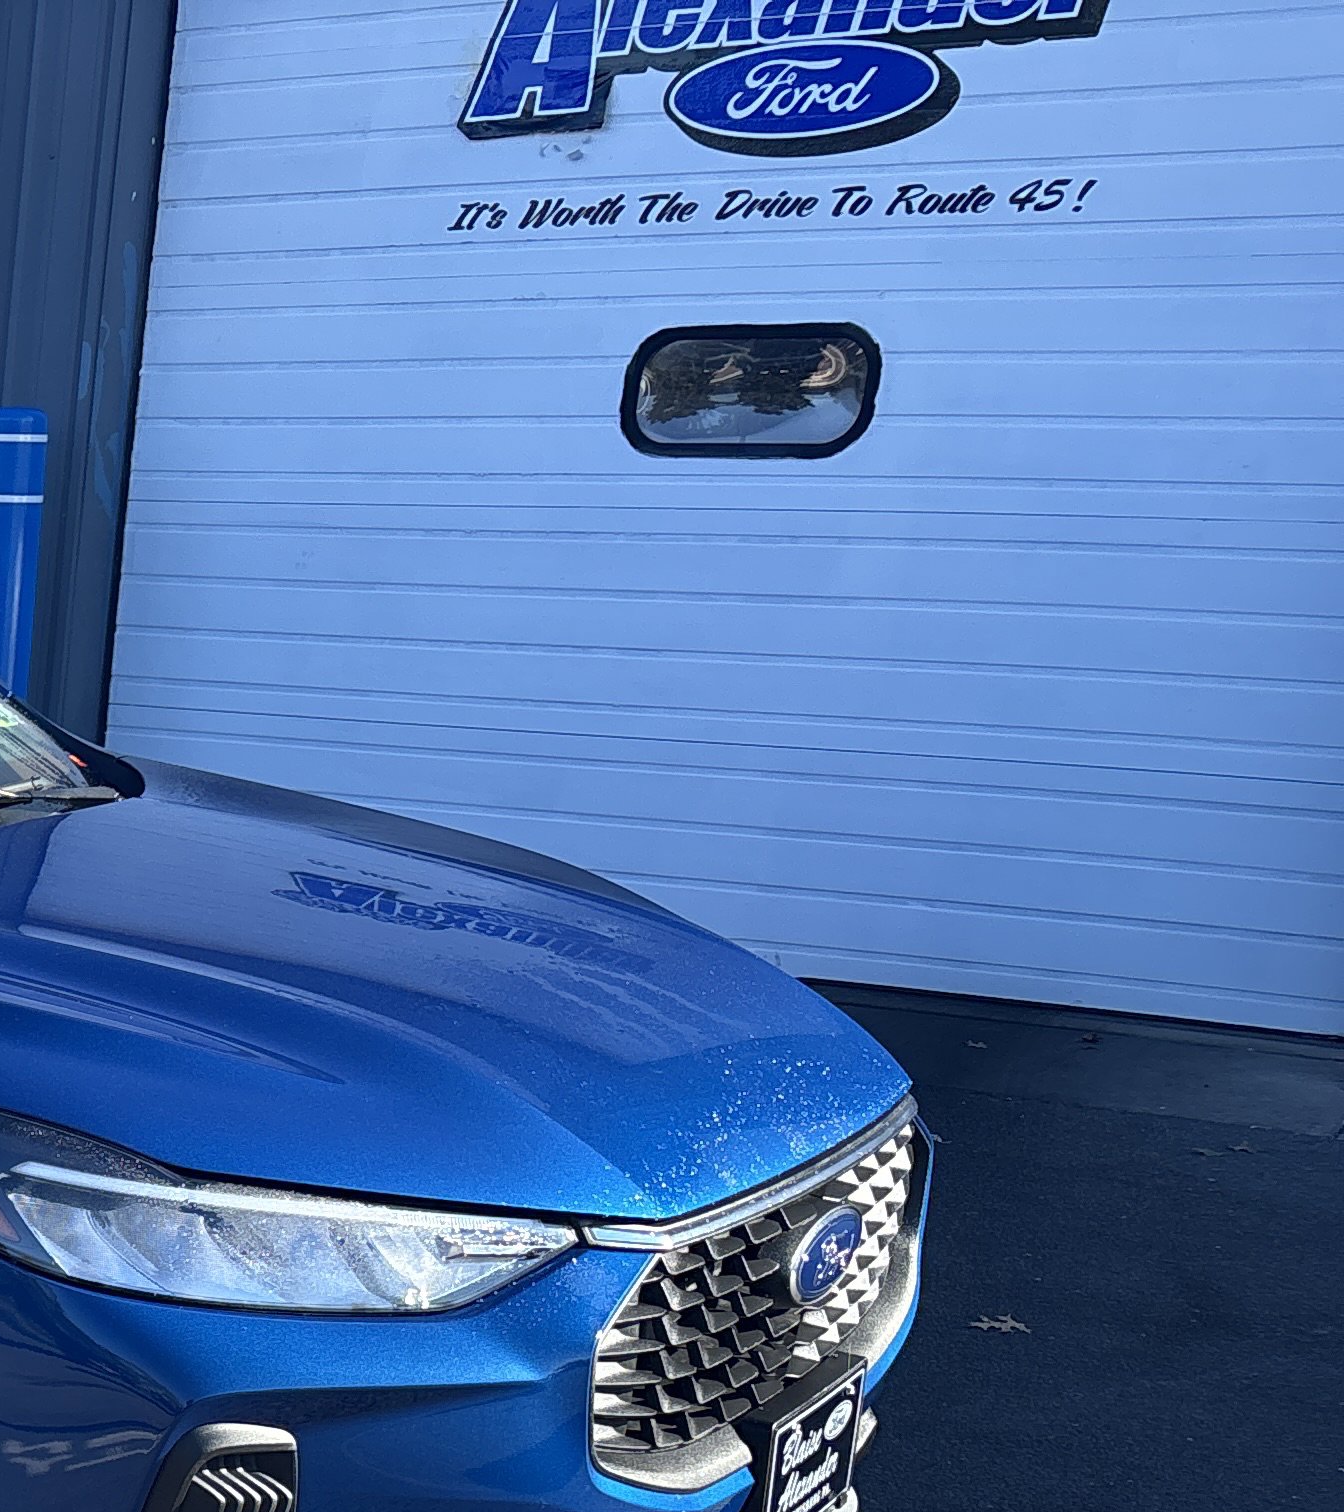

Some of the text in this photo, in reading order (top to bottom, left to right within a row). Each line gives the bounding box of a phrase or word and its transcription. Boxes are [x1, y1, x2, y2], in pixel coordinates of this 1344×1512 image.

[462, 0, 1090, 124] Alexa
[727, 57, 873, 120] Ford
[446, 201, 509, 232] It's
[517, 193, 627, 230] Worth
[638, 191, 700, 225] The
[714, 188, 820, 222] Drive
[831, 185, 874, 218] To
[884, 183, 996, 216] Route
[781, 1428, 823, 1475] Blaise
